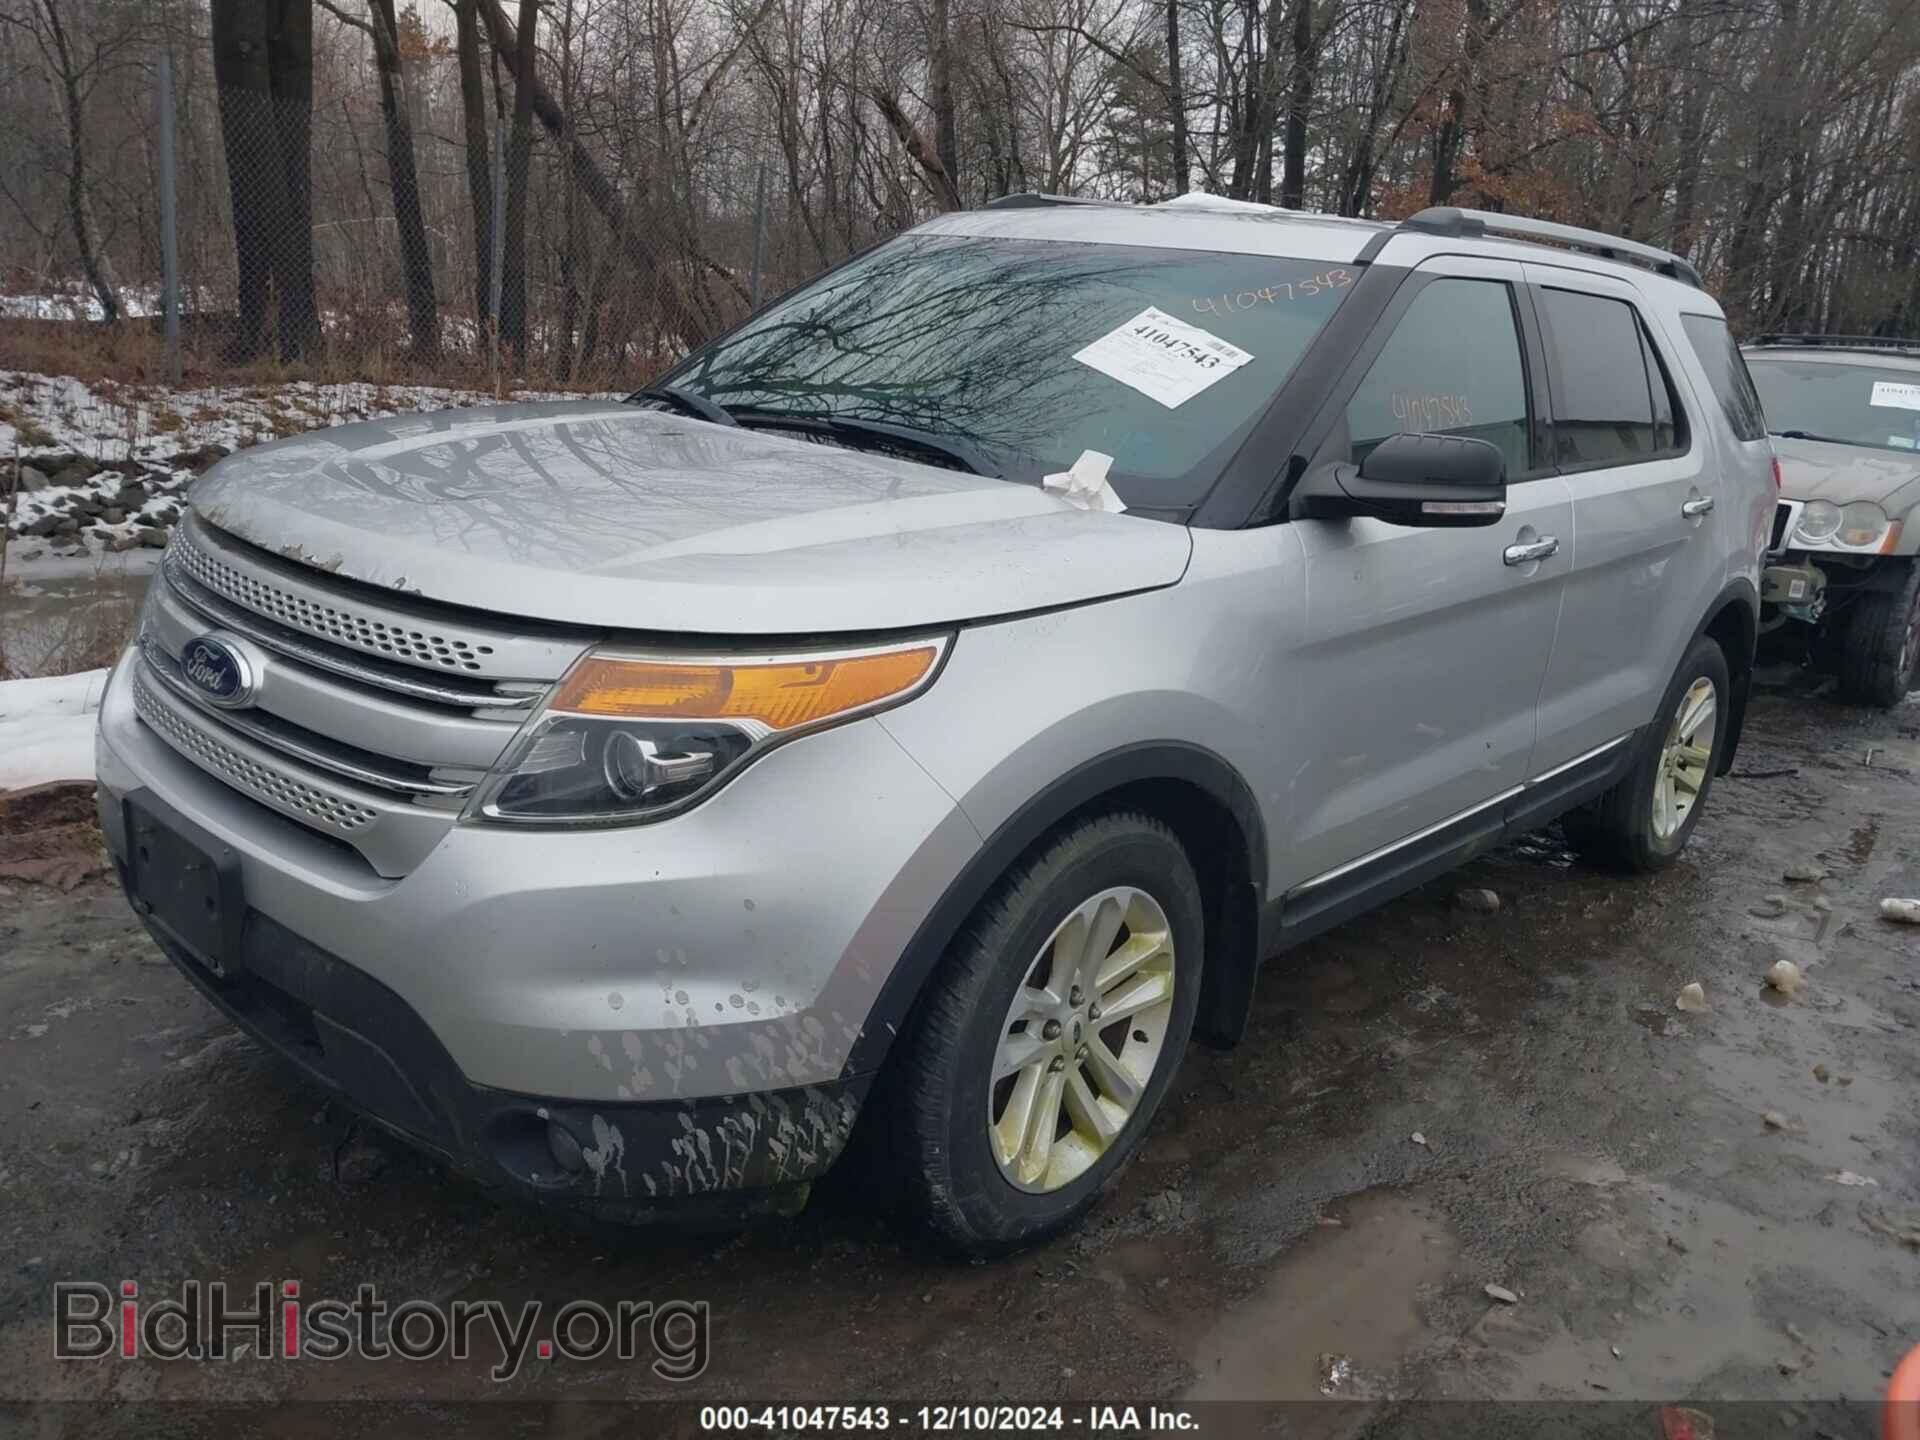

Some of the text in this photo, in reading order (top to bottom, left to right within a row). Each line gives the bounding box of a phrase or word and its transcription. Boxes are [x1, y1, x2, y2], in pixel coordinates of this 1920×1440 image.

[1191, 268, 1352, 318] 41047543
[1133, 324, 1221, 369] 41047543
[187, 644, 228, 690] Ford
